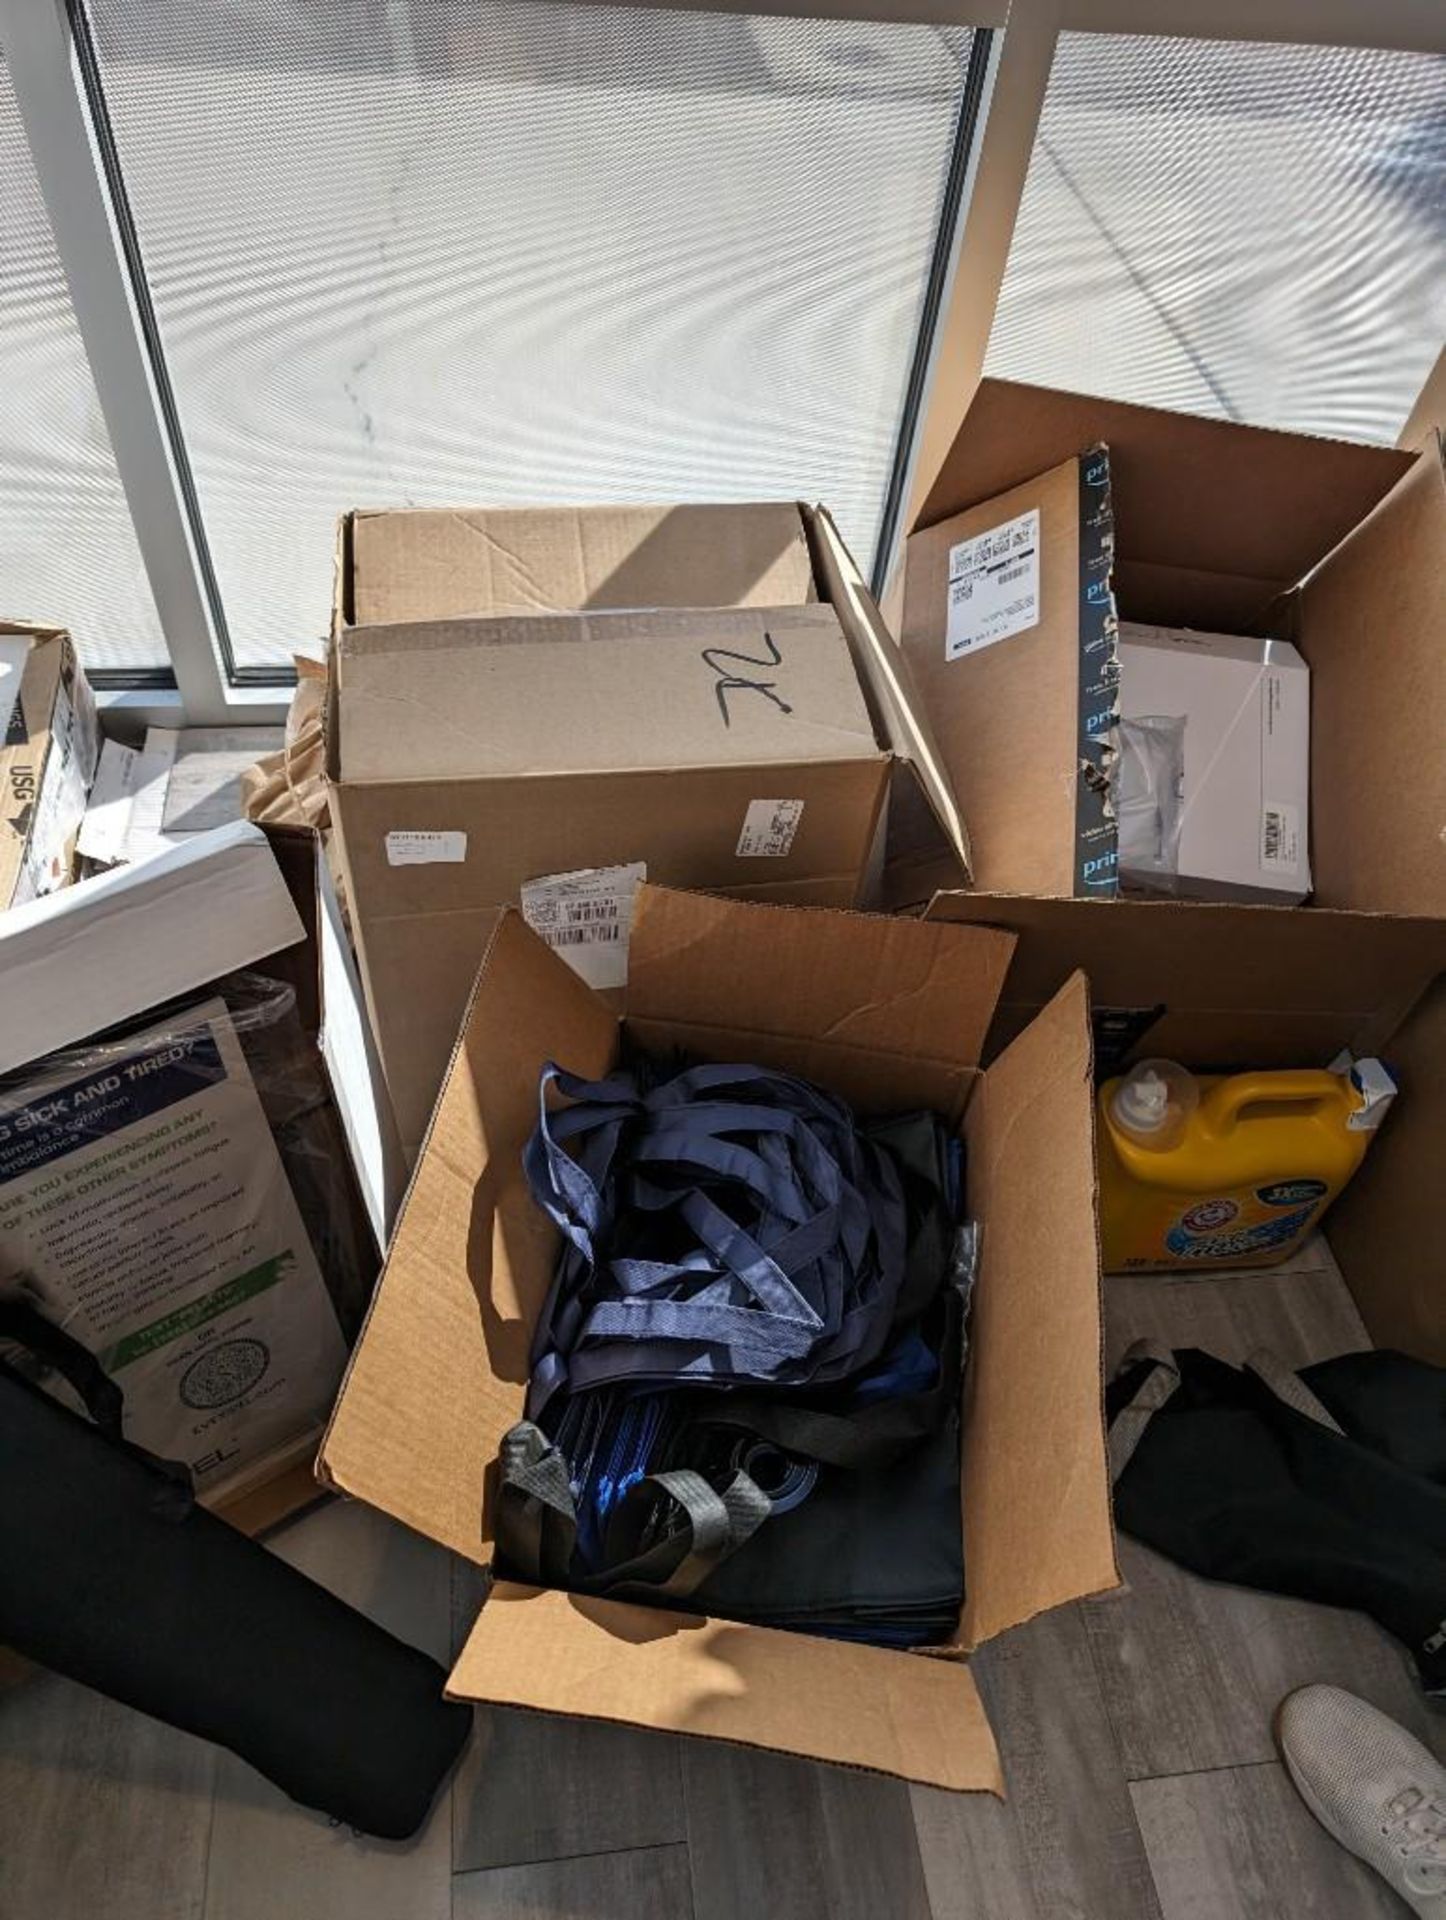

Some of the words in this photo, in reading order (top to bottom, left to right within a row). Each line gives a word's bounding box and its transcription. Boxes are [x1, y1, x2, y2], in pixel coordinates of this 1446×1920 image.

[10, 765, 35, 801] USG
[17, 1099, 68, 1131] SICK
[75, 1075, 120, 1106] AND
[125, 1041, 194, 1080] TIRED?
[64, 1096, 129, 1130] common
[30, 1178, 61, 1198] YOU
[65, 1127, 171, 1179] EXPERIENCING
[173, 1109, 204, 1129] ANY
[27, 1193, 76, 1219] THESE
[77, 1168, 127, 1194] OTHER
